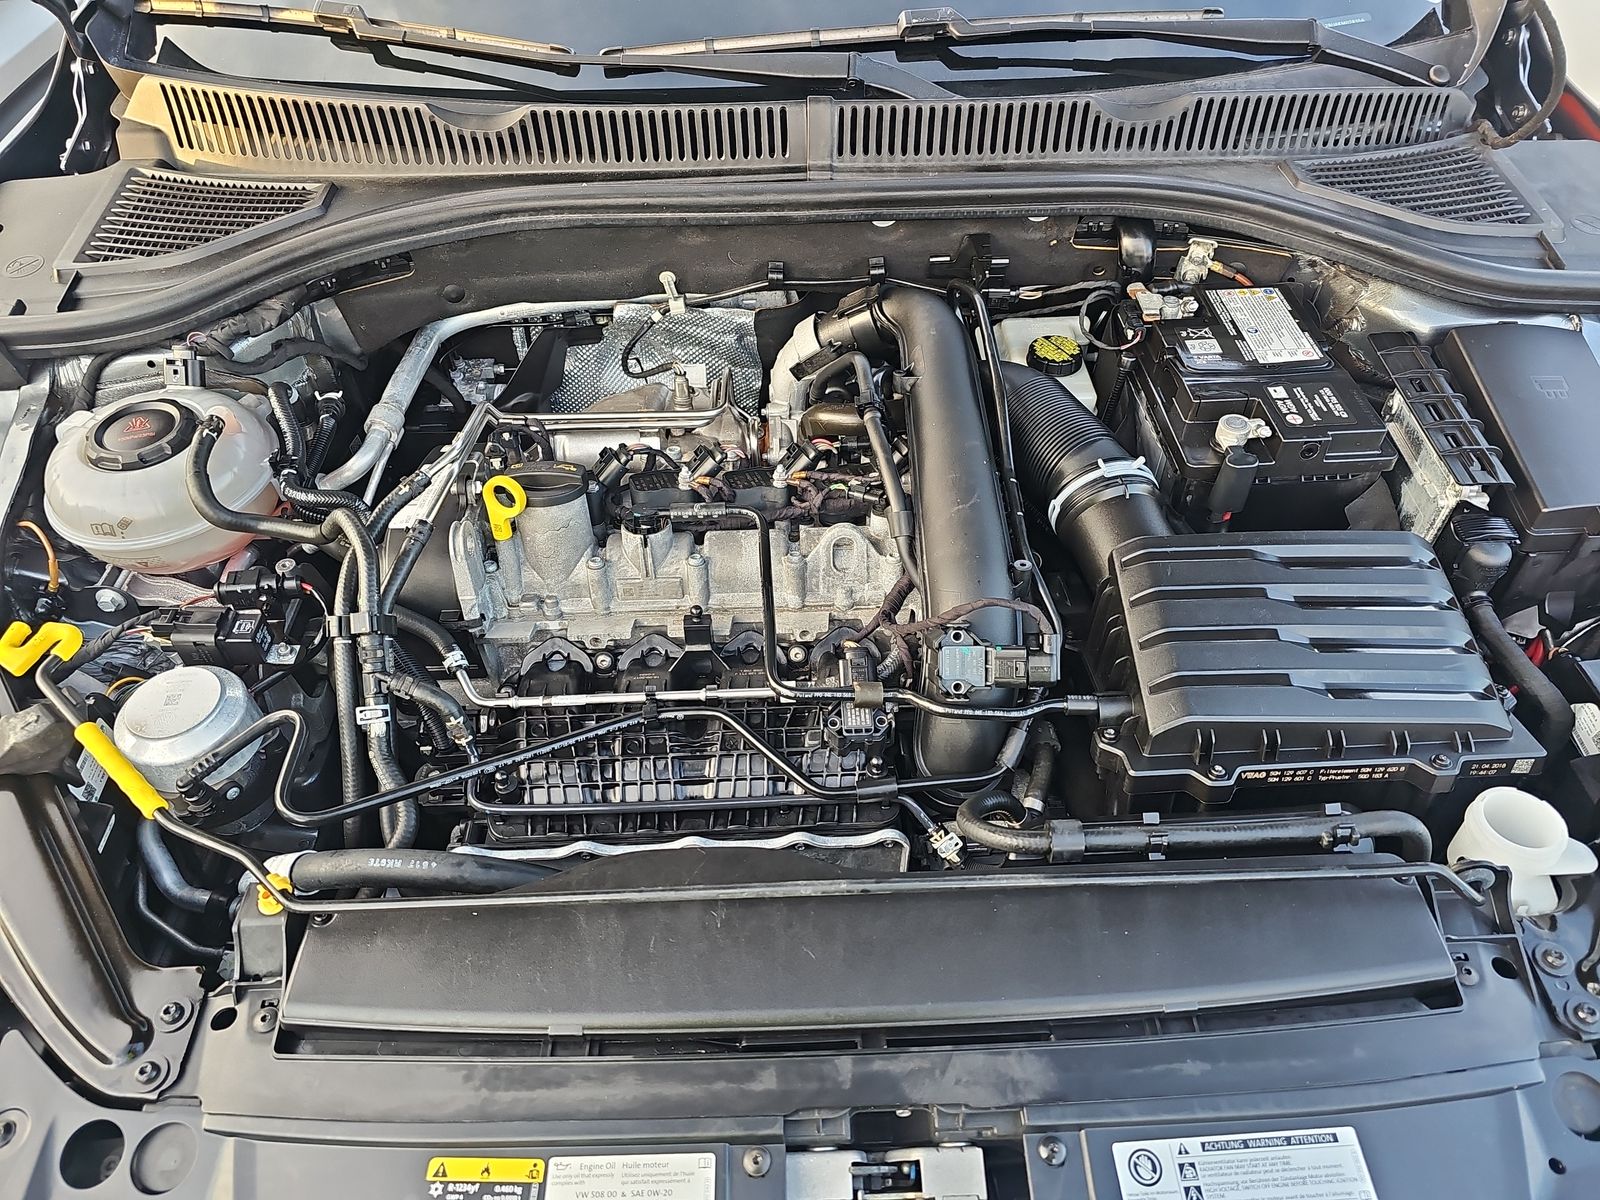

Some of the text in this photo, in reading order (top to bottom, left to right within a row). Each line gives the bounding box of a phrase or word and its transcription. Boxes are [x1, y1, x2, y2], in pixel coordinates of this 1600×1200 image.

[1204, 1134, 1332, 1150] ACHTUNG WARNING ATTENTION
[580, 1163, 604, 1172] Engine
[607, 1190, 618, 1198] 00
